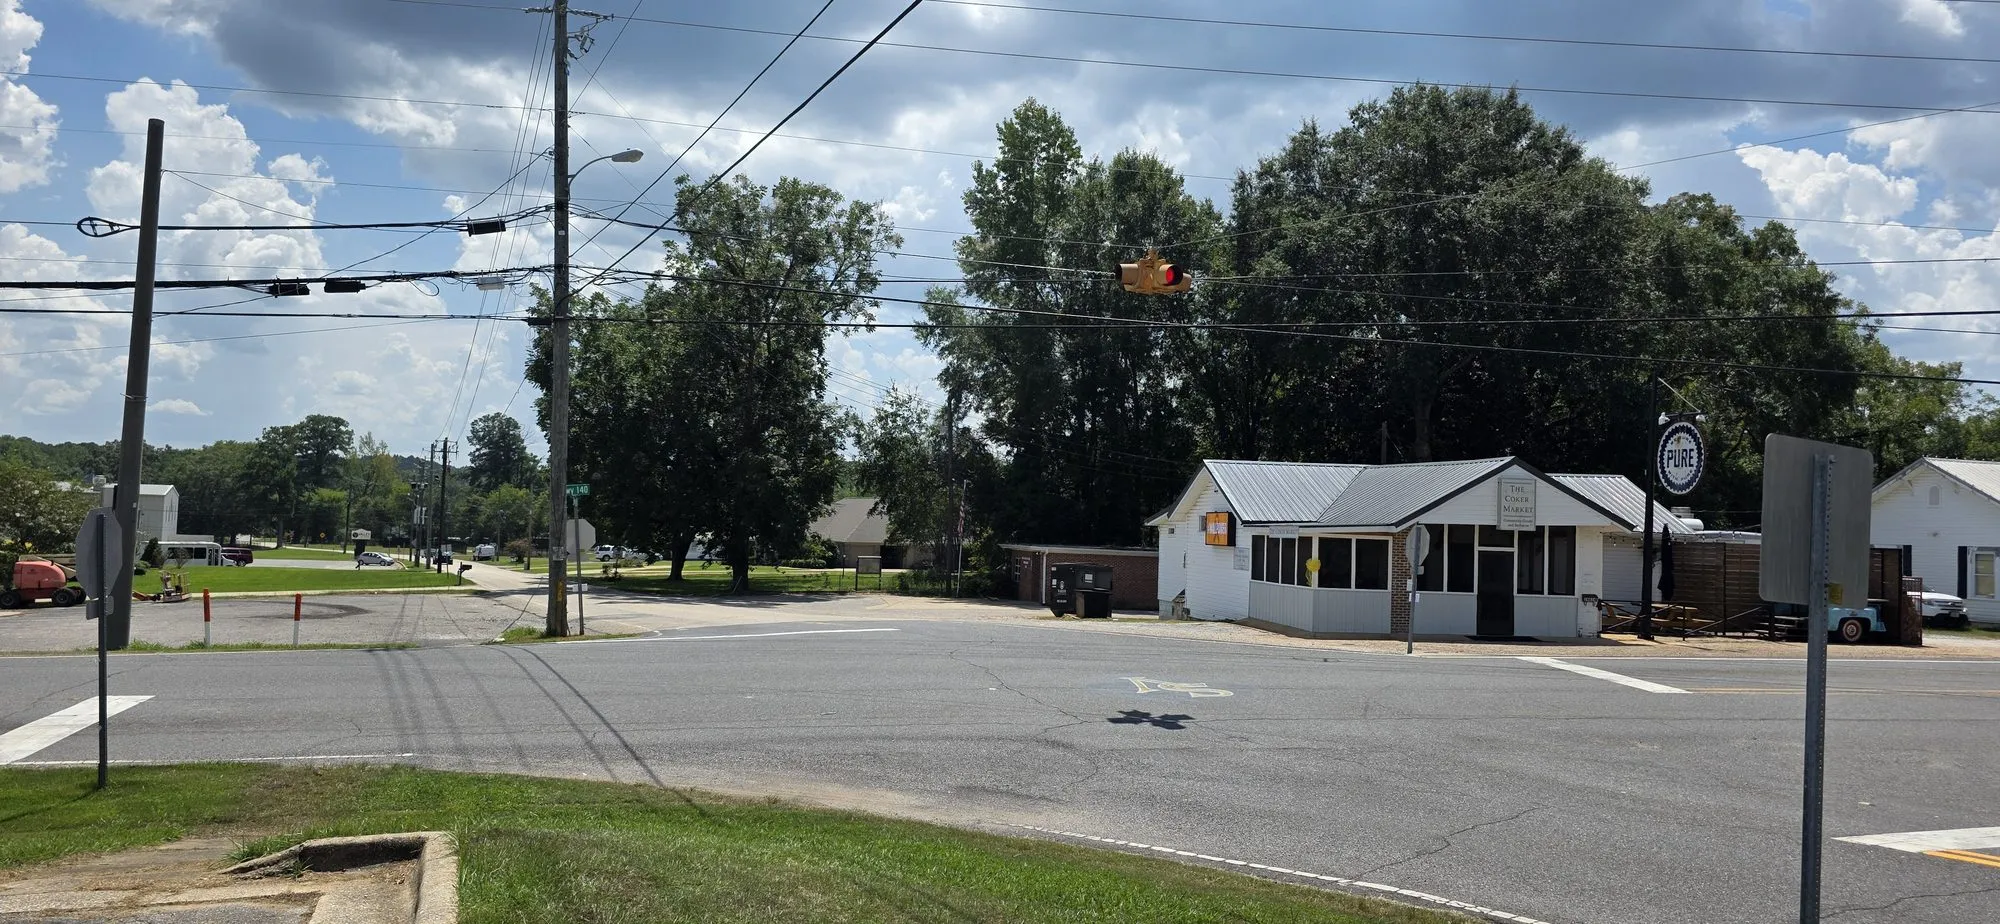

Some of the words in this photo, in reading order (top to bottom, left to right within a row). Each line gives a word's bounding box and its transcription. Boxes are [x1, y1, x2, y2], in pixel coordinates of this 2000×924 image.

[1667, 448, 1694, 468] PURE
[577, 485, 588, 494] 140
[1503, 505, 1534, 513] MARKET
